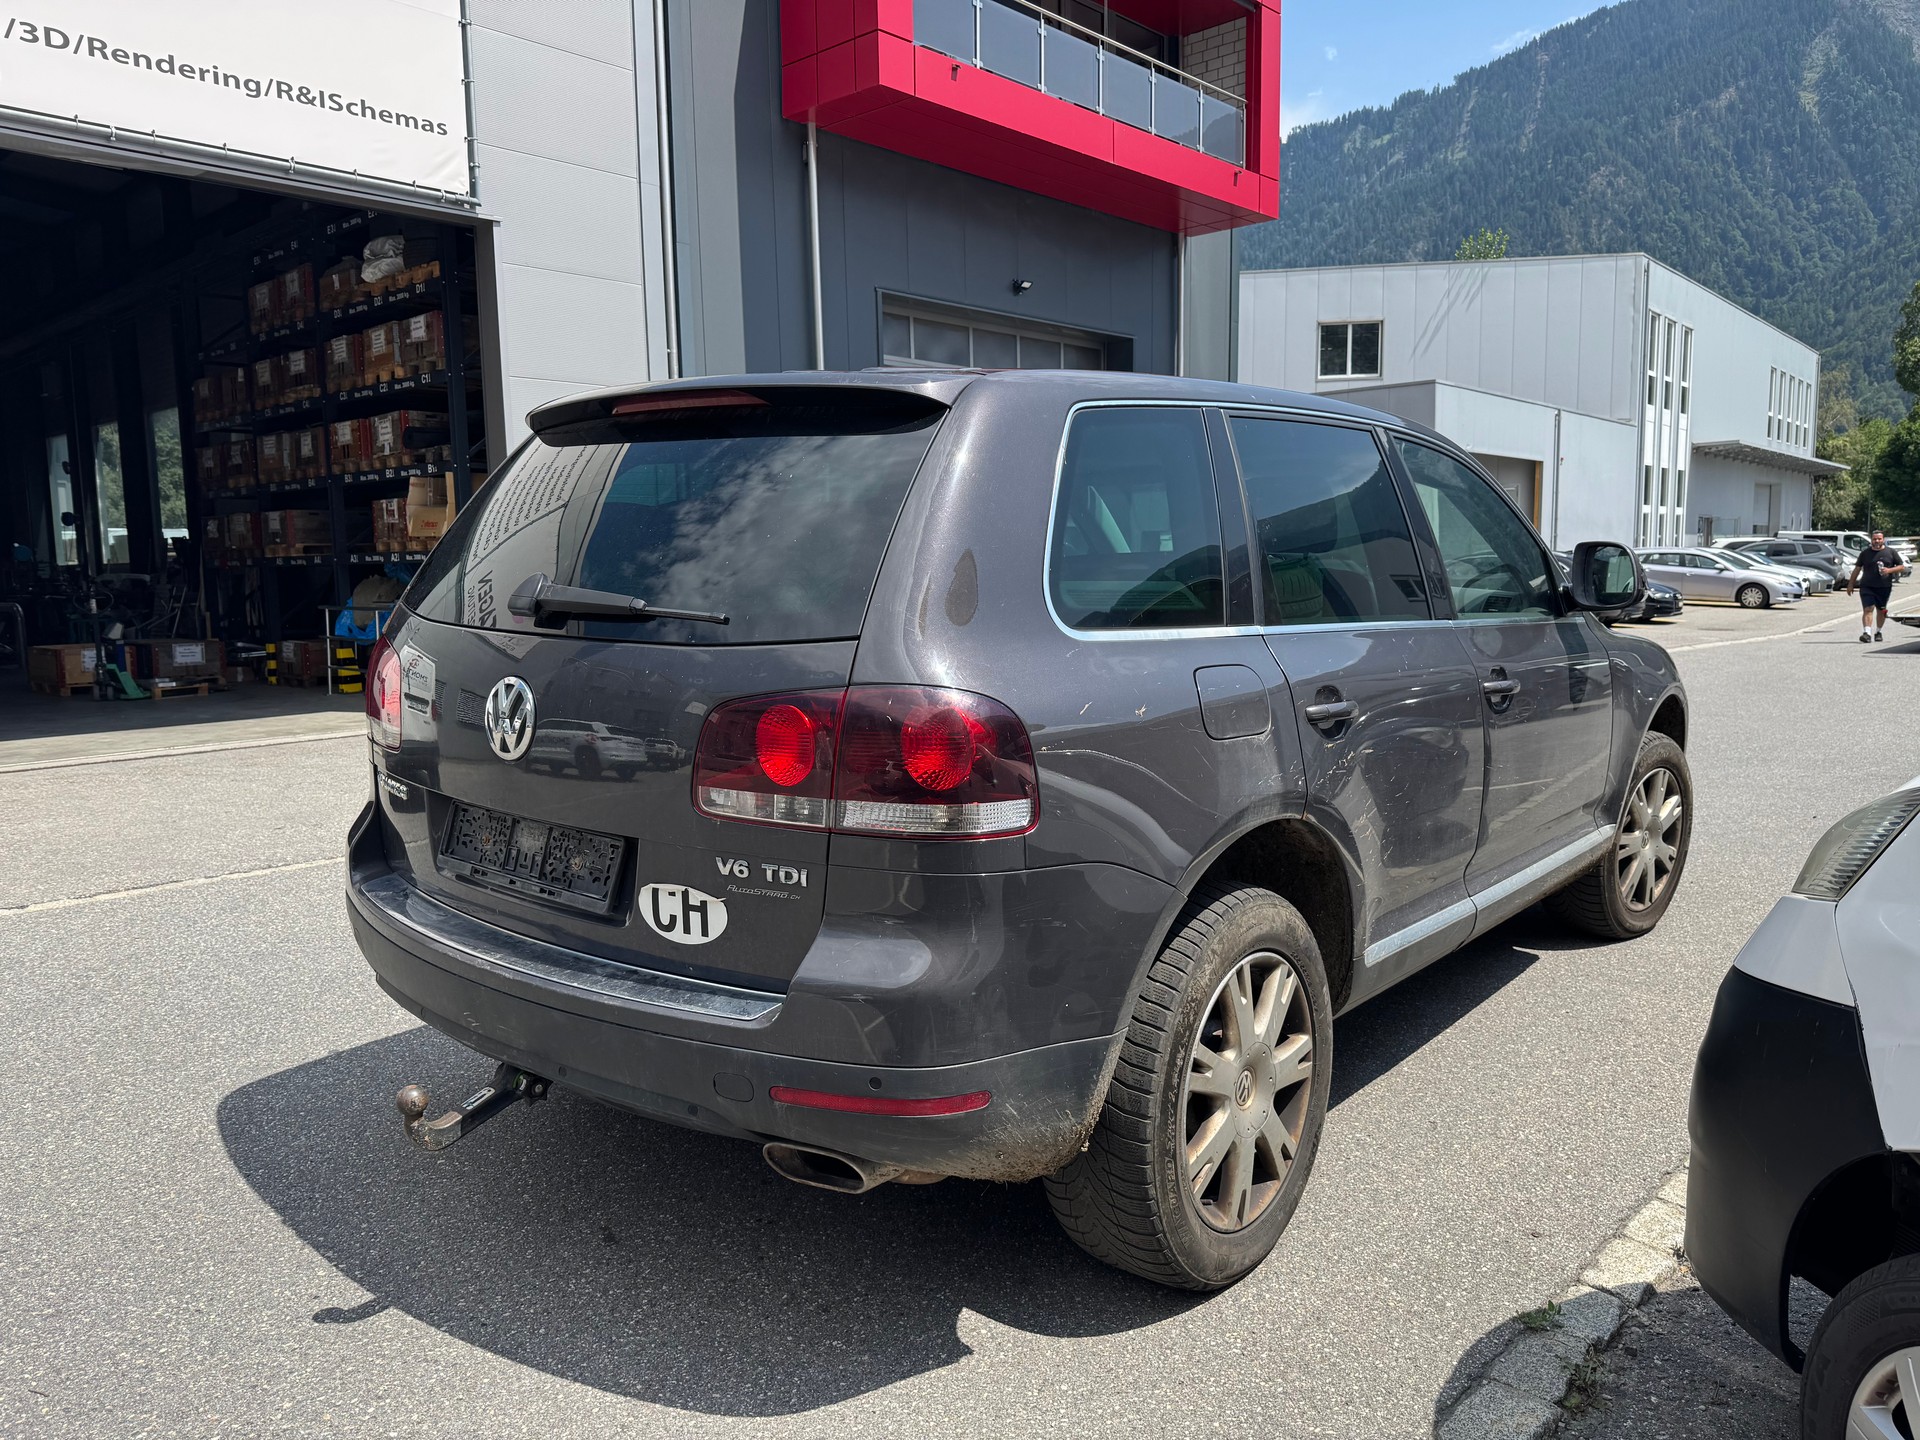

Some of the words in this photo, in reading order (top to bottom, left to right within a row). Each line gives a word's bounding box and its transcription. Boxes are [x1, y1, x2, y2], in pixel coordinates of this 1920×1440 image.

[4, 17, 448, 137] /3D/Rendering/R&ISchemas
[716, 857, 750, 879] V6
[761, 863, 808, 888] TDI
